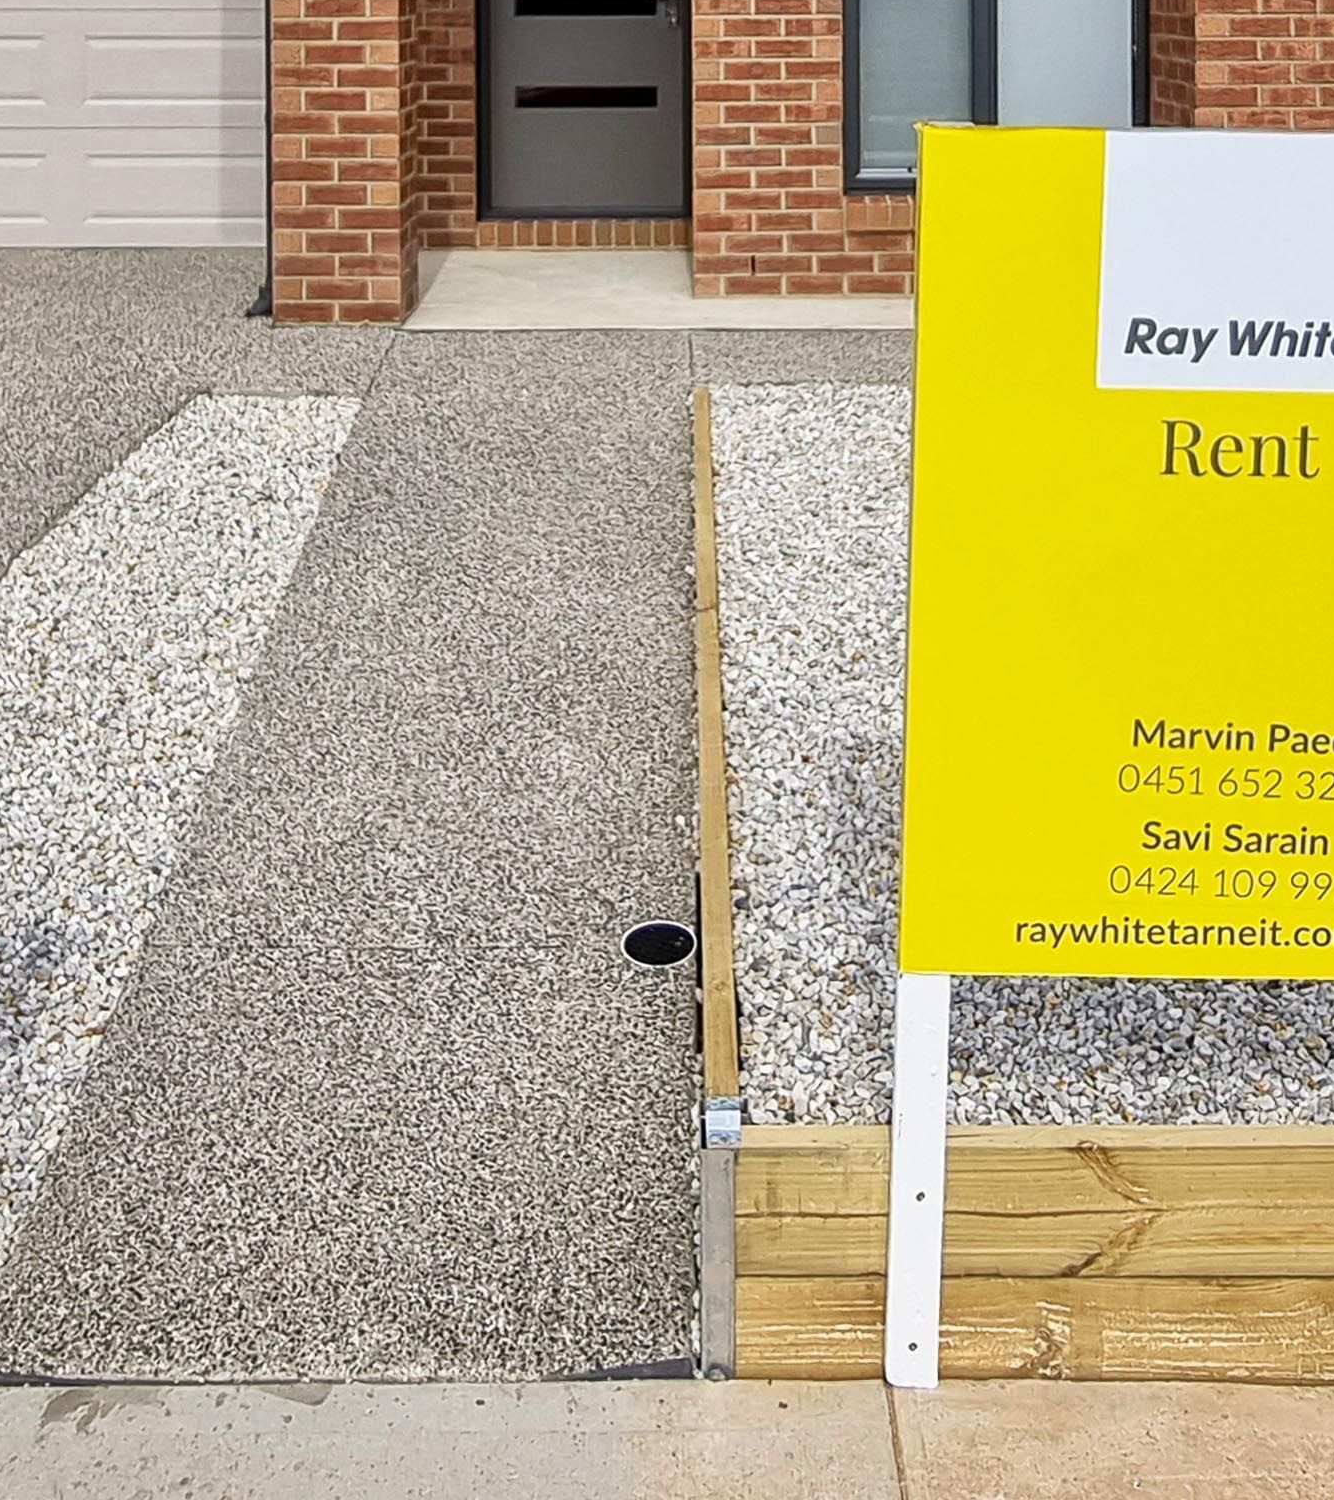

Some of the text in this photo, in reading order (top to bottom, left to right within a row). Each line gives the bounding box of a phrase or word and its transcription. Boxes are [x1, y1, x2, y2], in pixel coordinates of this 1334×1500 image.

[1124, 318, 1219, 363] Ray
[1160, 420, 1320, 479] Rent
[1133, 719, 1254, 751] Marvin
[1119, 764, 1203, 795] 0451
[1219, 768, 1282, 798] 652
[1142, 821, 1328, 855] Savi Sarain
[1110, 866, 1199, 895] 0424
[1215, 869, 1276, 898] 109
